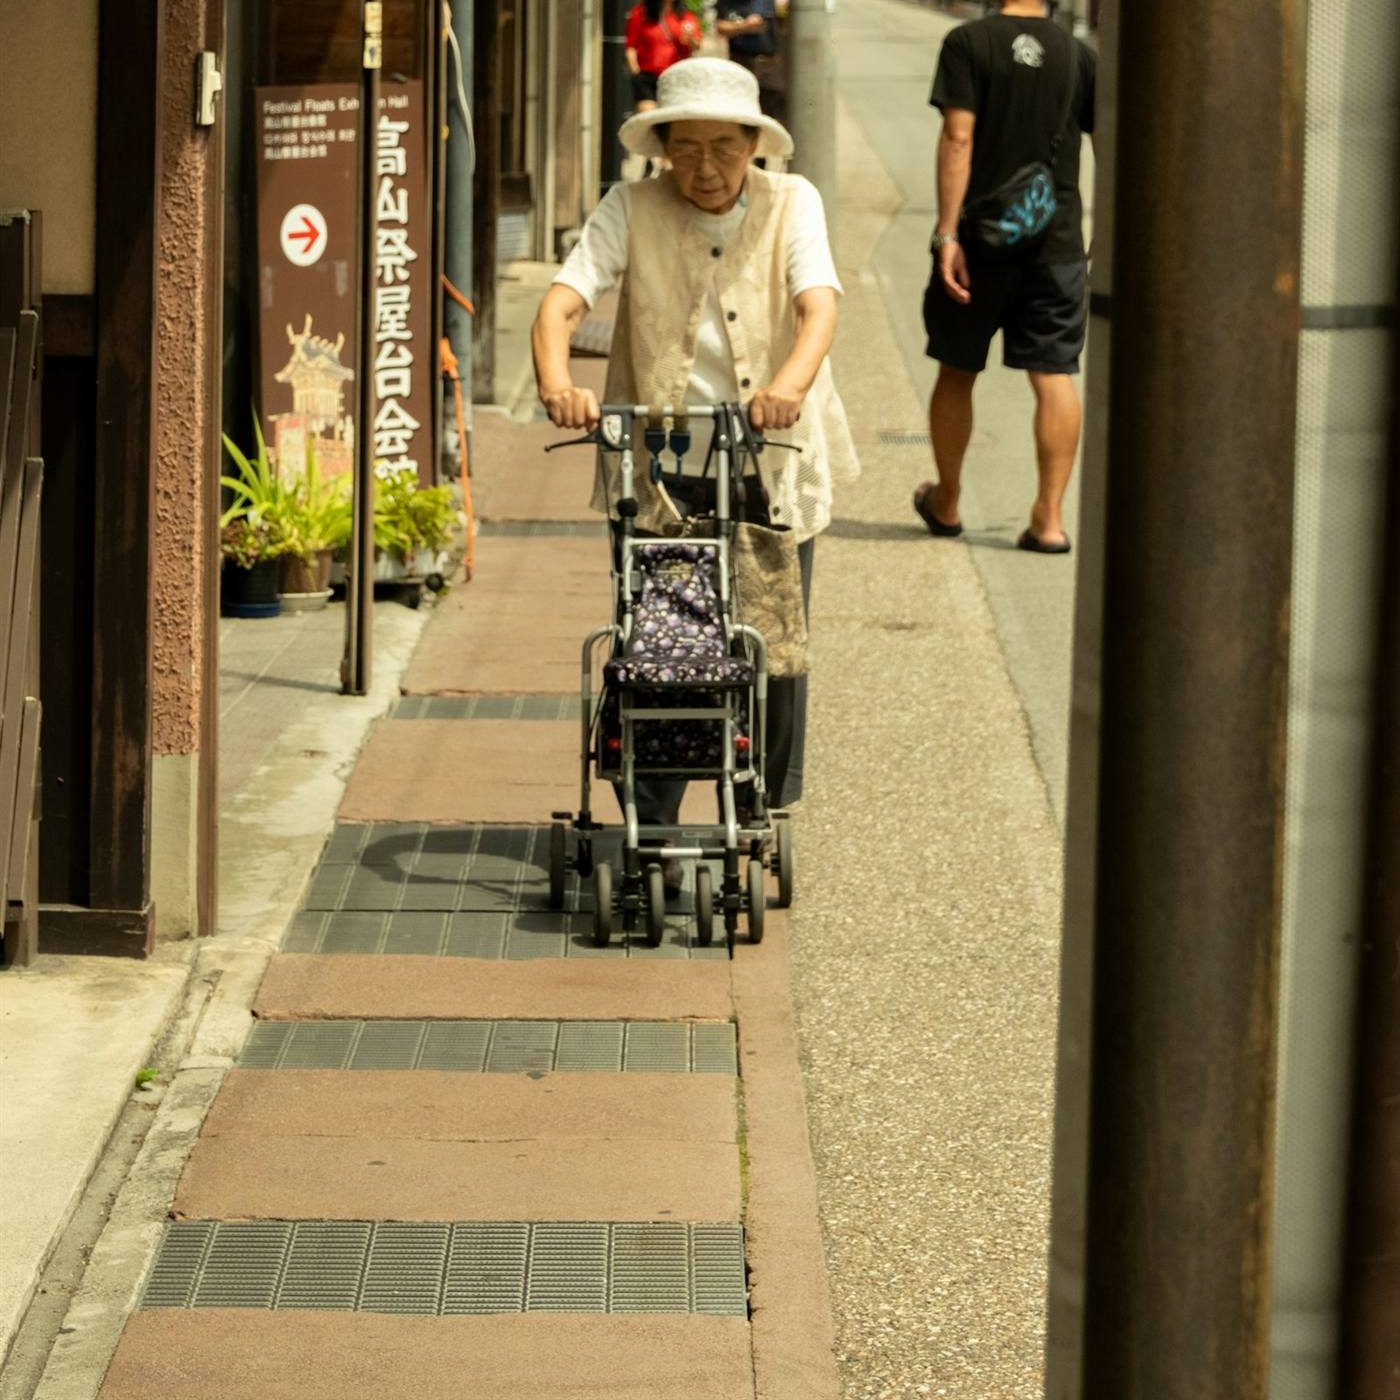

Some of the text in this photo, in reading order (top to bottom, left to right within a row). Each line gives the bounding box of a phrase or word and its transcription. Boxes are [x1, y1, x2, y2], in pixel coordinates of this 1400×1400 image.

[263, 100, 302, 114] Festival
[304, 98, 336, 112] Floats
[388, 95, 408, 109] Hall
